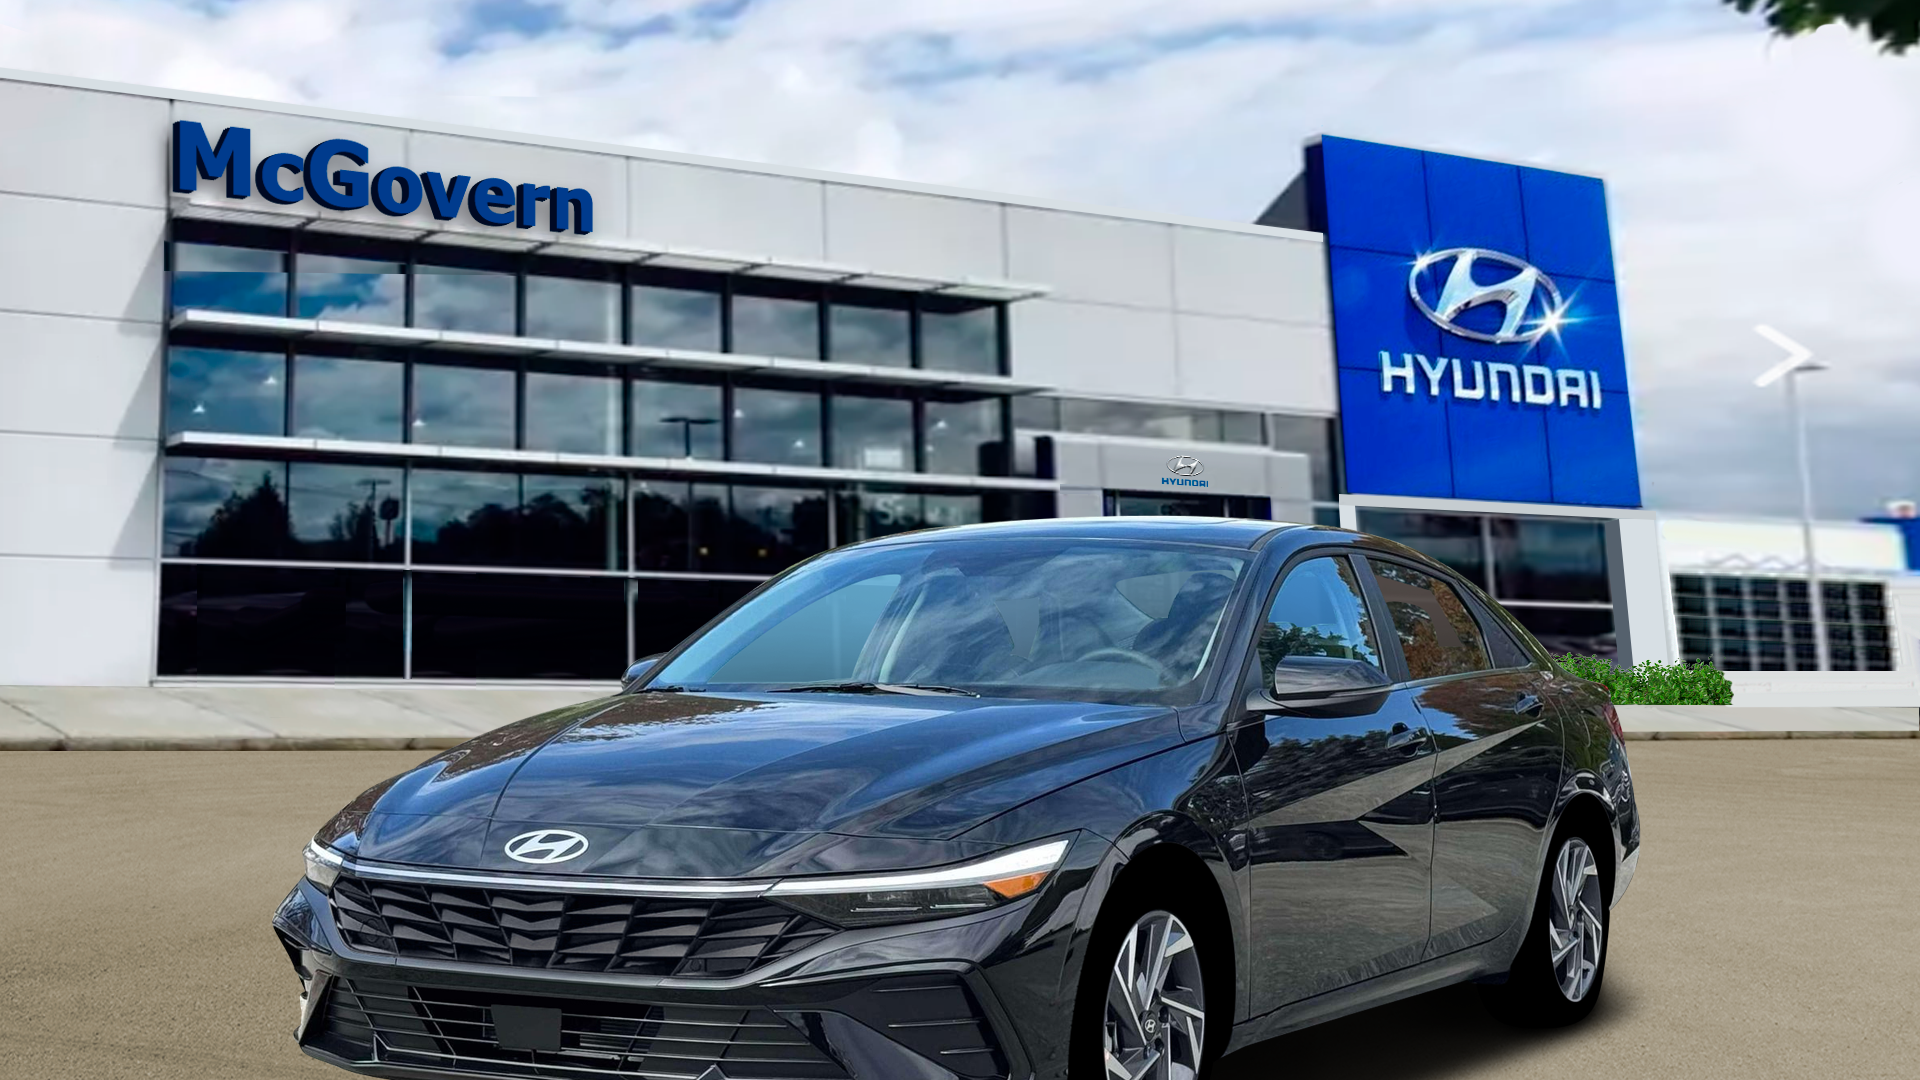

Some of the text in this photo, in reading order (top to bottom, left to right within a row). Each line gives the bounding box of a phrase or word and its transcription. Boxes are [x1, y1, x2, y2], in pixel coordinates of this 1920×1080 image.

[172, 119, 594, 236] McGovern
[1379, 350, 1602, 409] HYUNDAI
[1161, 477, 1209, 488] HYUNDAI
